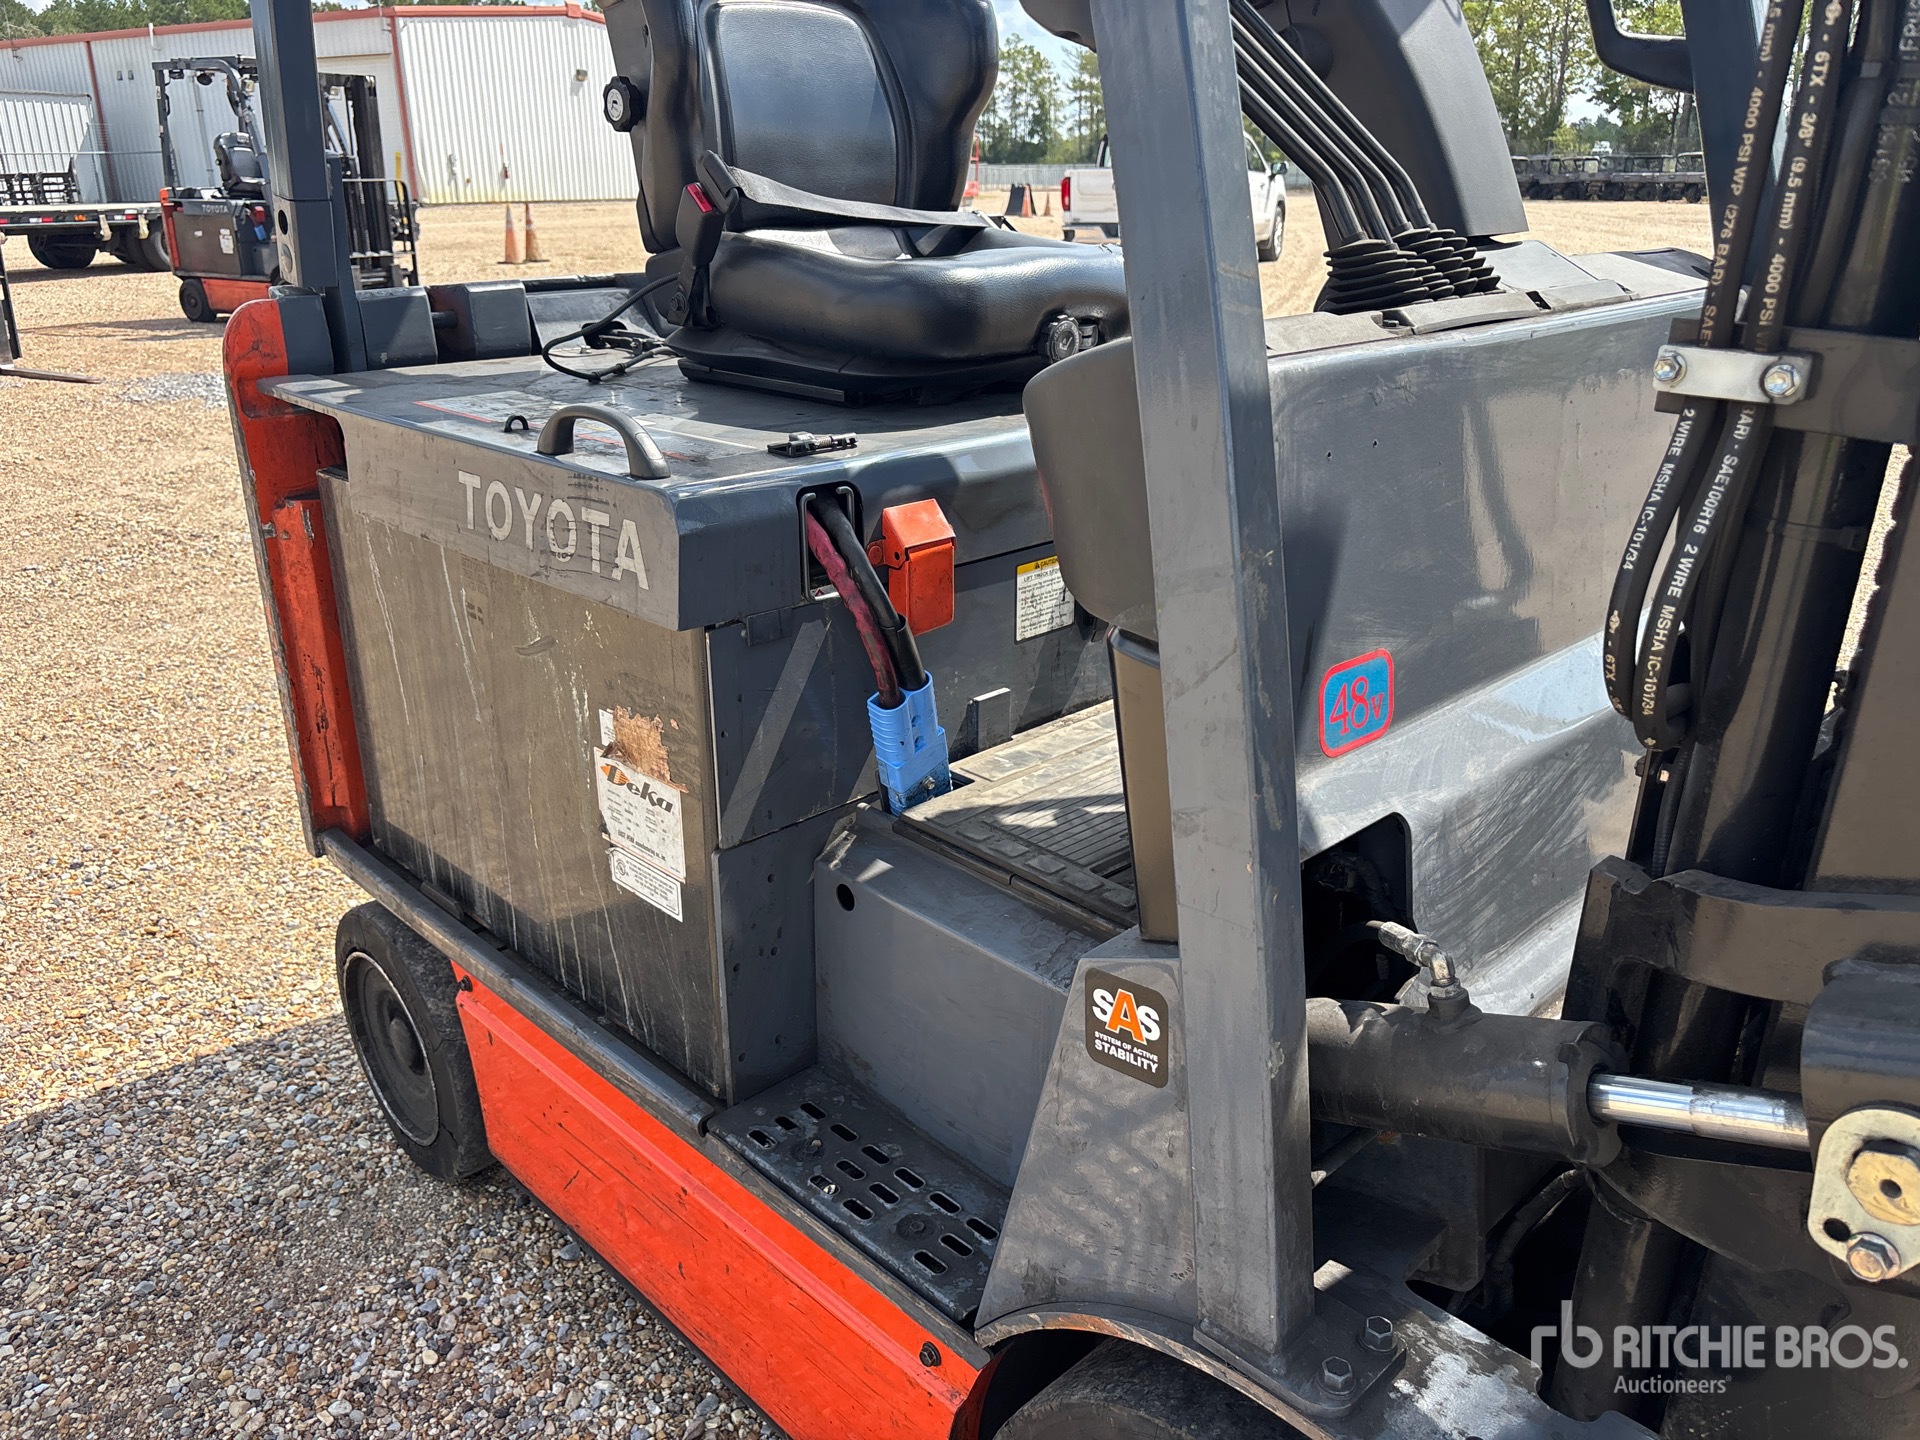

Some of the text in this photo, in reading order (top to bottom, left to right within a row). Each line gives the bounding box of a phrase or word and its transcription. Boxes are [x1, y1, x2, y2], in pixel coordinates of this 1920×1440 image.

[1808, 51, 1831, 87] 6TX
[1744, 86, 1764, 129] 4000
[1736, 133, 1755, 163] PSI
[1730, 165, 1748, 196] WP
[1787, 156, 1809, 188] (9.5
[201, 204, 229, 214] TOYOTA
[1719, 204, 1740, 240] (276
[1778, 191, 1797, 230] mm)
[1710, 243, 1730, 286] BAR)
[1764, 253, 1786, 294] 4000
[1758, 297, 1777, 326] PSI
[1682, 408, 1695, 418] 2
[1667, 420, 1694, 457] WIRE
[1648, 463, 1676, 502] MSHA
[1693, 454, 1739, 535] SAE100R16
[458, 470, 649, 591] TOYOTA
[1622, 506, 1657, 570] IC-101/34
[1684, 543, 1699, 555] 2
[1667, 557, 1695, 598] WIRE
[1650, 604, 1677, 651] MSHA
[1605, 653, 1617, 682] 6TX
[1641, 655, 1663, 716] IC-101/34
[601, 763, 674, 813] Deka
[1092, 988, 1161, 1045] SAS
[1094, 1030, 1159, 1062] SYSTEM OF ACTIVE
[1094, 1038, 1159, 1074] STABILITY
